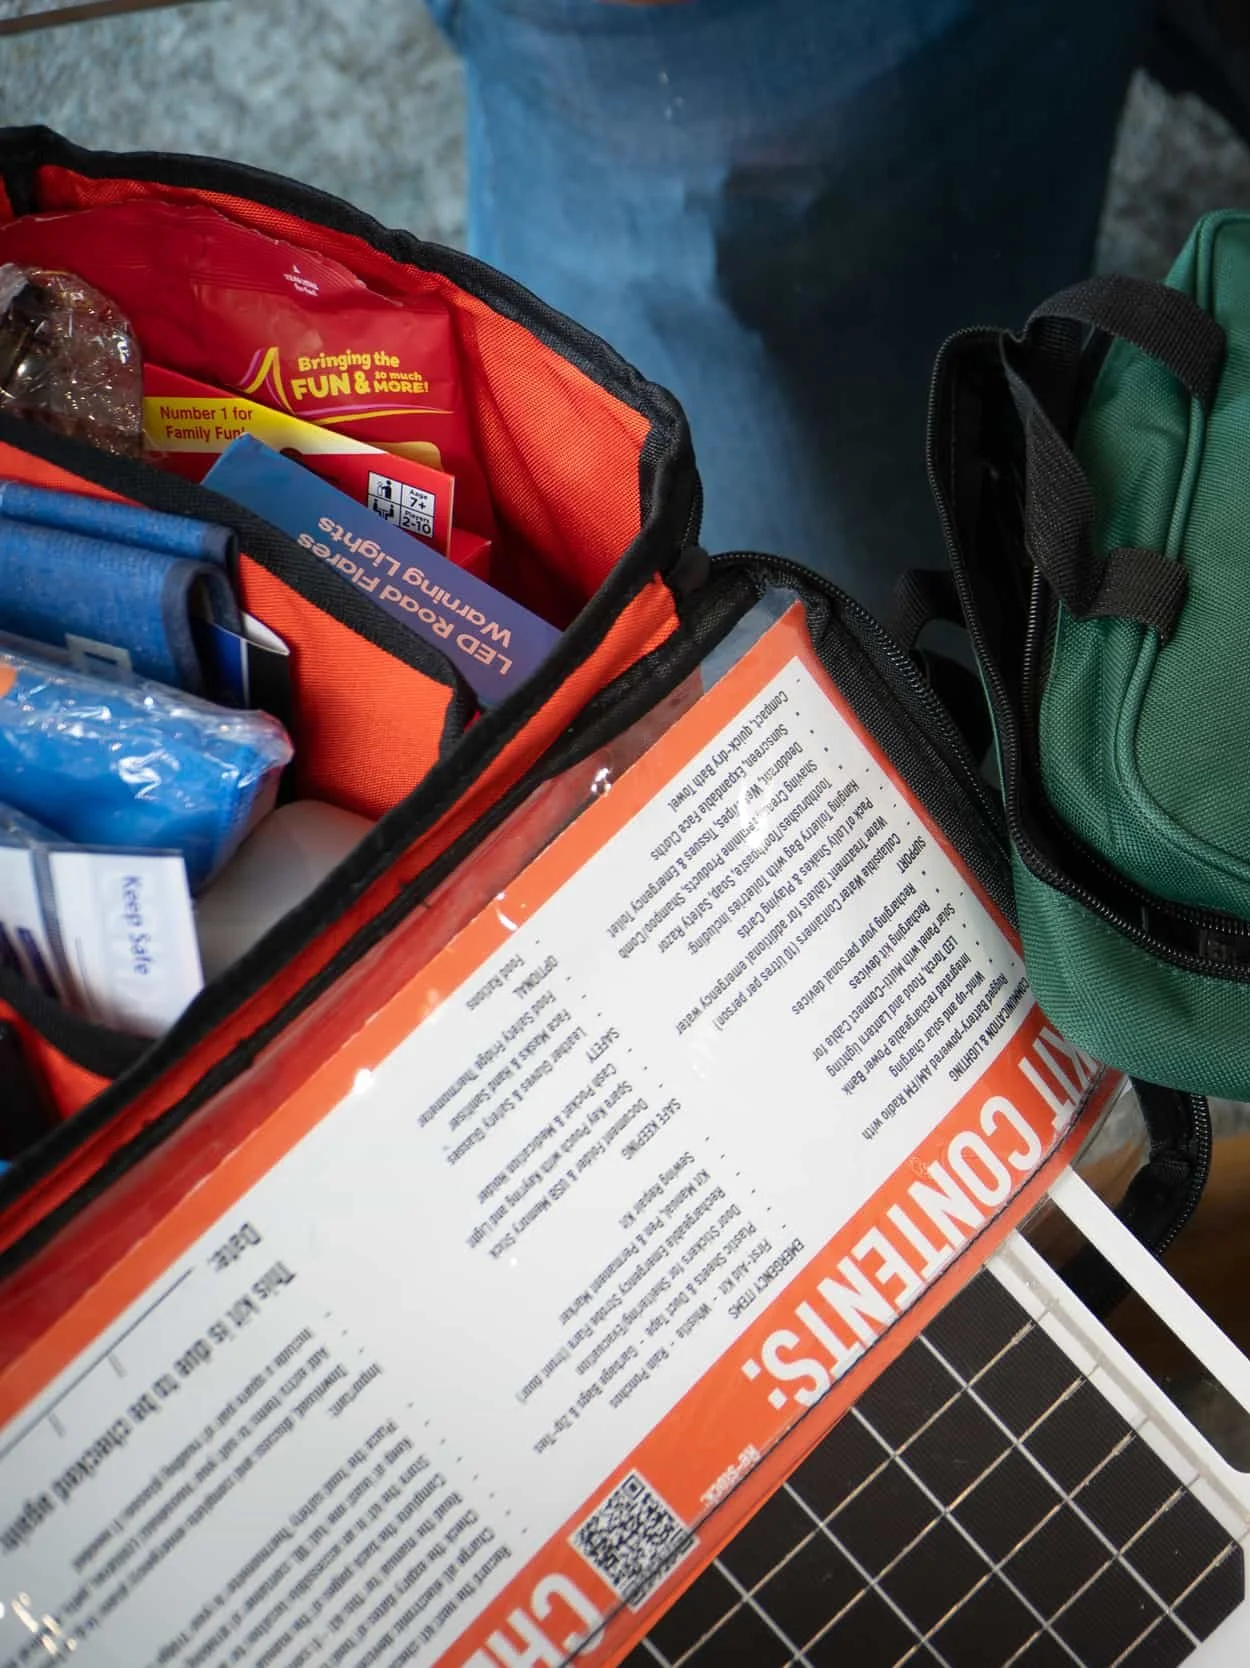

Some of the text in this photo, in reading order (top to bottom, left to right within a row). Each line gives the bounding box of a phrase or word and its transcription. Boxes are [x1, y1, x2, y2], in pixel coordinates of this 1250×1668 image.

[298, 350, 400, 371] Bringing the
[374, 371, 423, 381] so much
[291, 371, 429, 400] FUN & MORE!
[160, 406, 254, 420] Number 1 for
[166, 425, 211, 443] Family
[409, 496, 427, 510] 7+
[402, 516, 431, 534] 2-10
[297, 533, 513, 675] LED Road Flares
[318, 517, 512, 649] Warning Lights
[666, 690, 789, 813] Compact, quick-dry Bath Towel
[649, 723, 788, 861] Sunscreen, Expandable Face Cloths
[782, 758, 818, 793] Shaving
[843, 814, 856, 831] of
[851, 796, 874, 820] Pack
[683, 827, 719, 861] Tissues
[825, 823, 850, 848] Lolly
[895, 835, 926, 874] SUPPORT
[679, 852, 725, 893] Products,
[687, 778, 860, 955] Hanging Toiletry Bag with Toiletries including:
[798, 843, 832, 876] Snakes
[630, 864, 680, 913] Emergency
[706, 874, 736, 899] Soap,
[759, 879, 796, 915] Playing
[122, 875, 154, 976] Keep Safe
[606, 910, 635, 938] Toilet
[618, 891, 686, 958] Shampoo/Comb
[675, 815, 888, 1035] Water Treatment Tablets for additional emergency water
[680, 897, 713, 929] Safety
[713, 832, 901, 1031] Collapsible Water Containers (10 litres per person)
[736, 910, 765, 939] Cards
[657, 924, 686, 953] Razor
[791, 882, 917, 1015] Recharging your personal devices
[848, 899, 930, 989] Recharging kit devices
[512, 954, 558, 999] OPTIONAL
[812, 902, 956, 1061] Solar Panel with Multi-Connect Cable for
[825, 934, 958, 1077] LED Torch, Flood and Lantern lighting
[840, 952, 971, 1095] Integrated rechargeable Power Bank
[888, 970, 985, 1077] Wind-up and solar charging
[984, 978, 1027, 1040] COMMUNICATION
[585, 1026, 620, 1064] SAFETY
[861, 972, 1008, 1140] Rugged Battery-powered AM/FM Radio with
[948, 1040, 984, 1082] LIGHTING
[620, 1097, 681, 1160] SAFE KEEPING
[741, 1026, 1100, 1412] KIT CONTENTS:
[727, 1237, 804, 1319] EMERGENCY ITEMS
